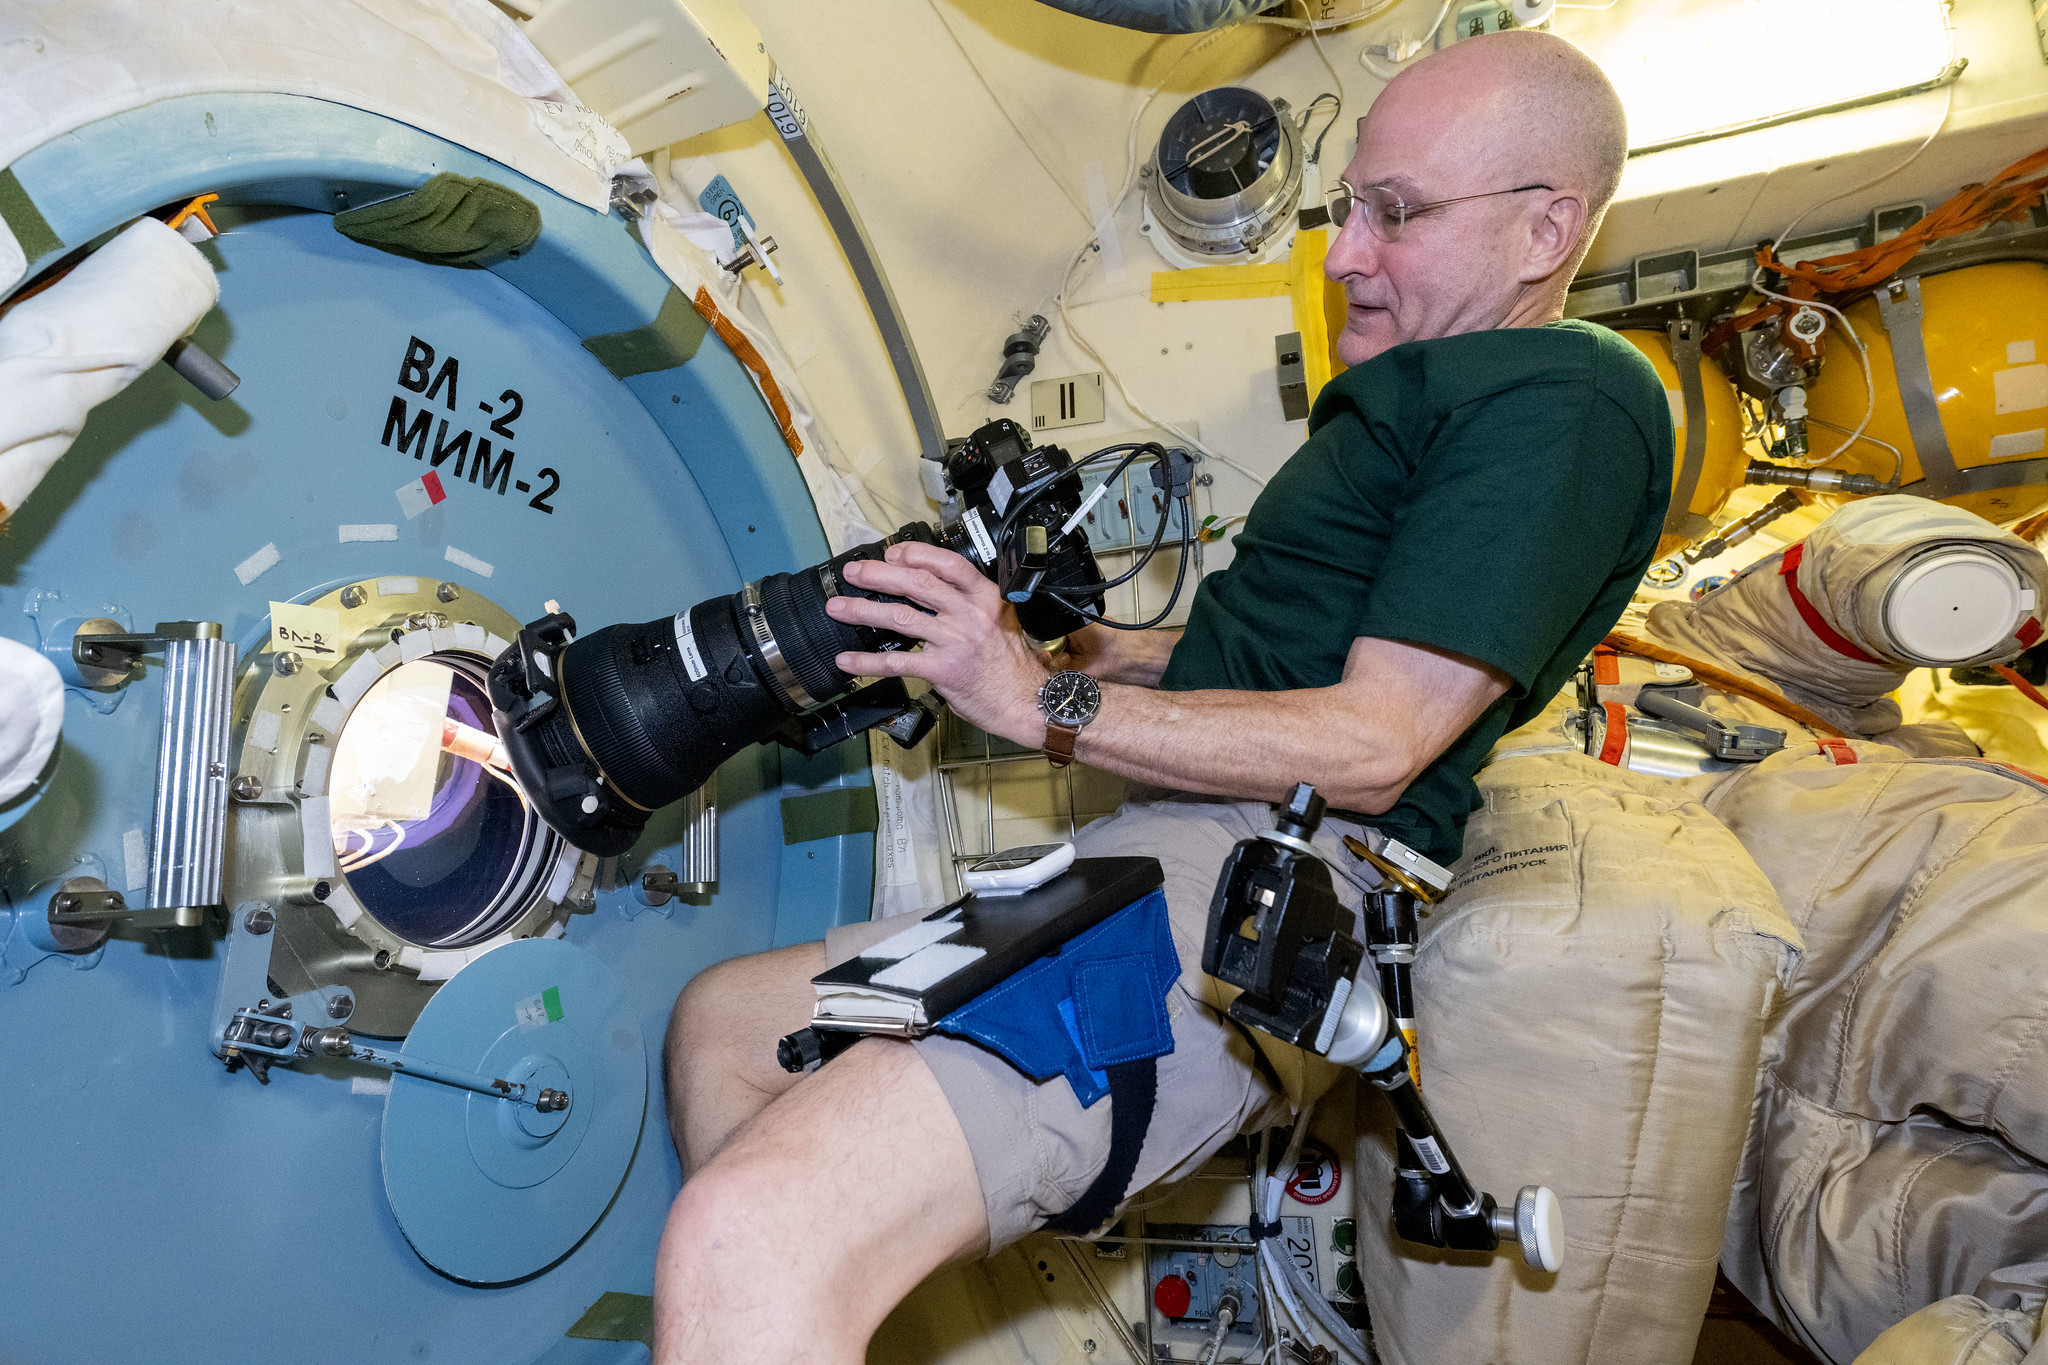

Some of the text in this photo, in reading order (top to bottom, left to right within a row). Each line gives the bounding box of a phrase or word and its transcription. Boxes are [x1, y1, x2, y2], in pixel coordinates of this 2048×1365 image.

[768, 92, 798, 134] 6101
[705, 180, 720, 199] ОТКР
[709, 187, 725, 205] OPEN
[398, 335, 459, 411] ВЛ
[381, 395, 561, 515] МИМ-2
[882, 759, 891, 788] hatch
[886, 845, 895, 869] axes
[1503, 844, 1569, 860] ПИТАНИЯ
[1459, 863, 1518, 889] ПИТАНИЯ
[1519, 858, 1548, 869] УСК
